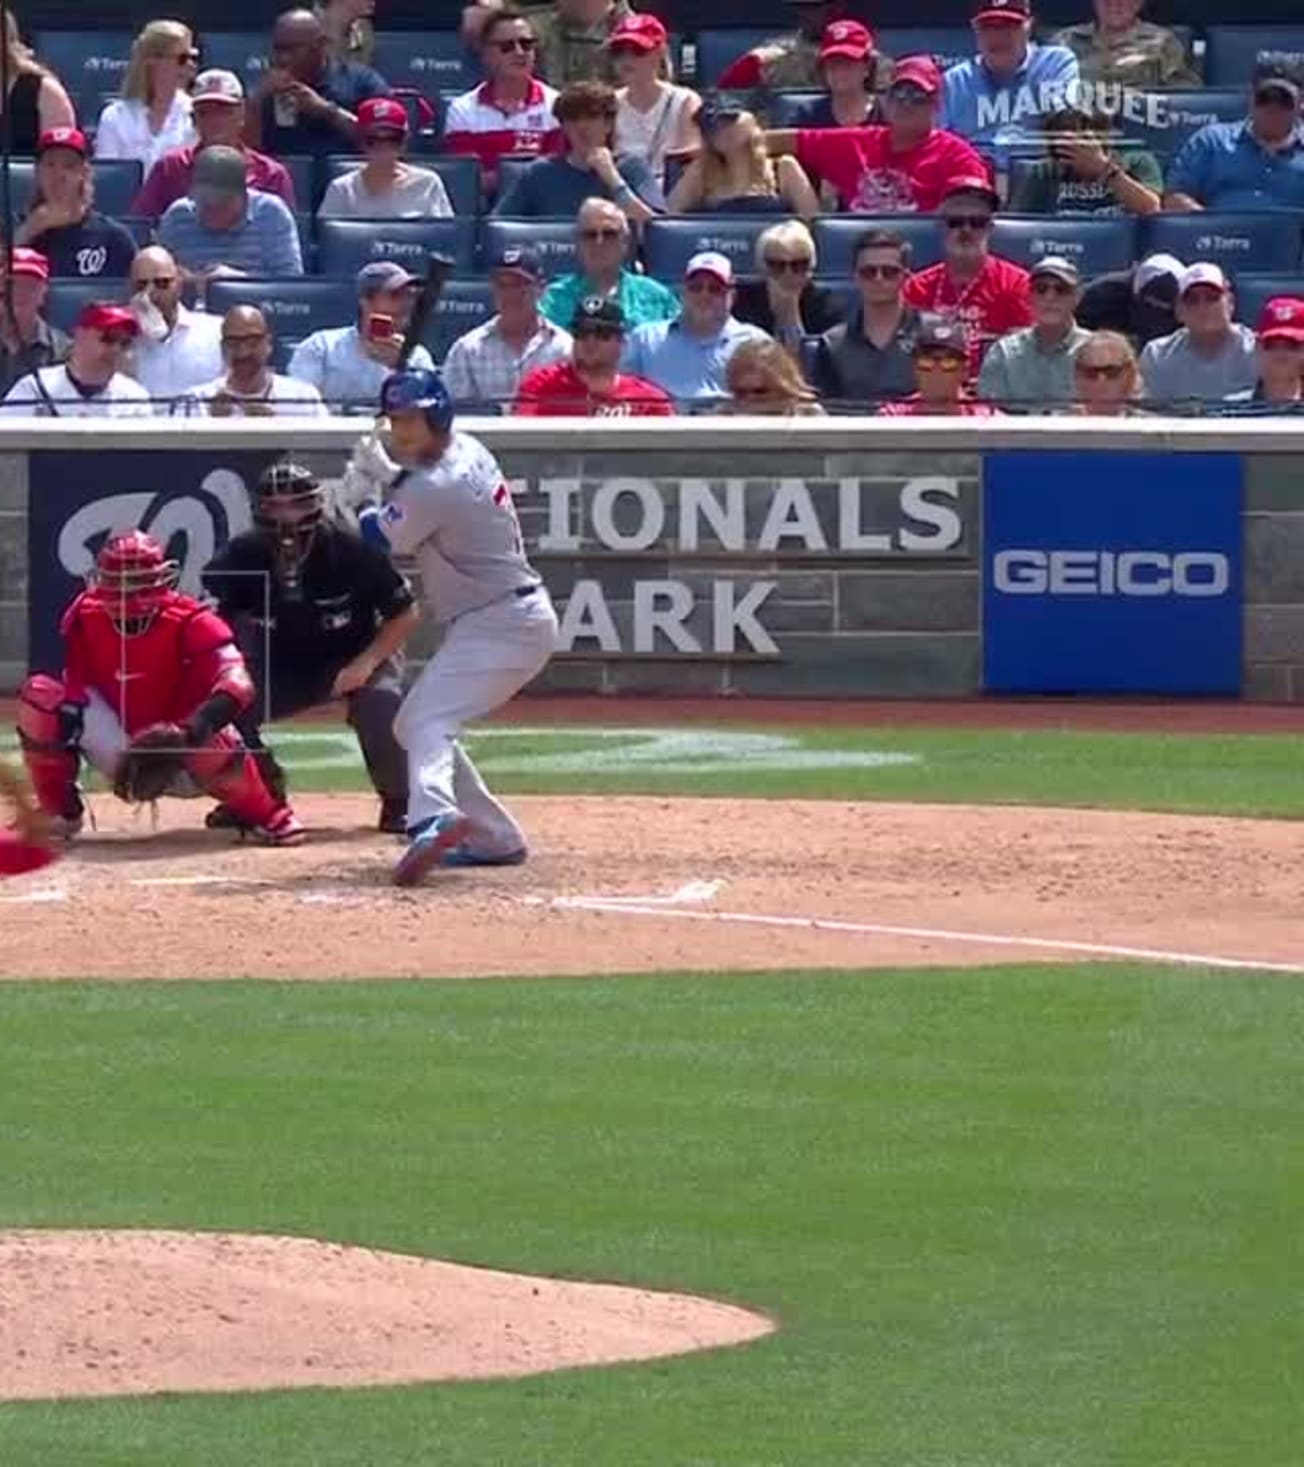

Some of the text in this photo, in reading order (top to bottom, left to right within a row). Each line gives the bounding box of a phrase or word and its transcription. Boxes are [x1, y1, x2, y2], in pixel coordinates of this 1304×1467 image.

[76, 247, 106, 275] W
[510, 476, 962, 553] IONALS
[994, 549, 1228, 595] GEICO
[554, 580, 782, 654] ARK
